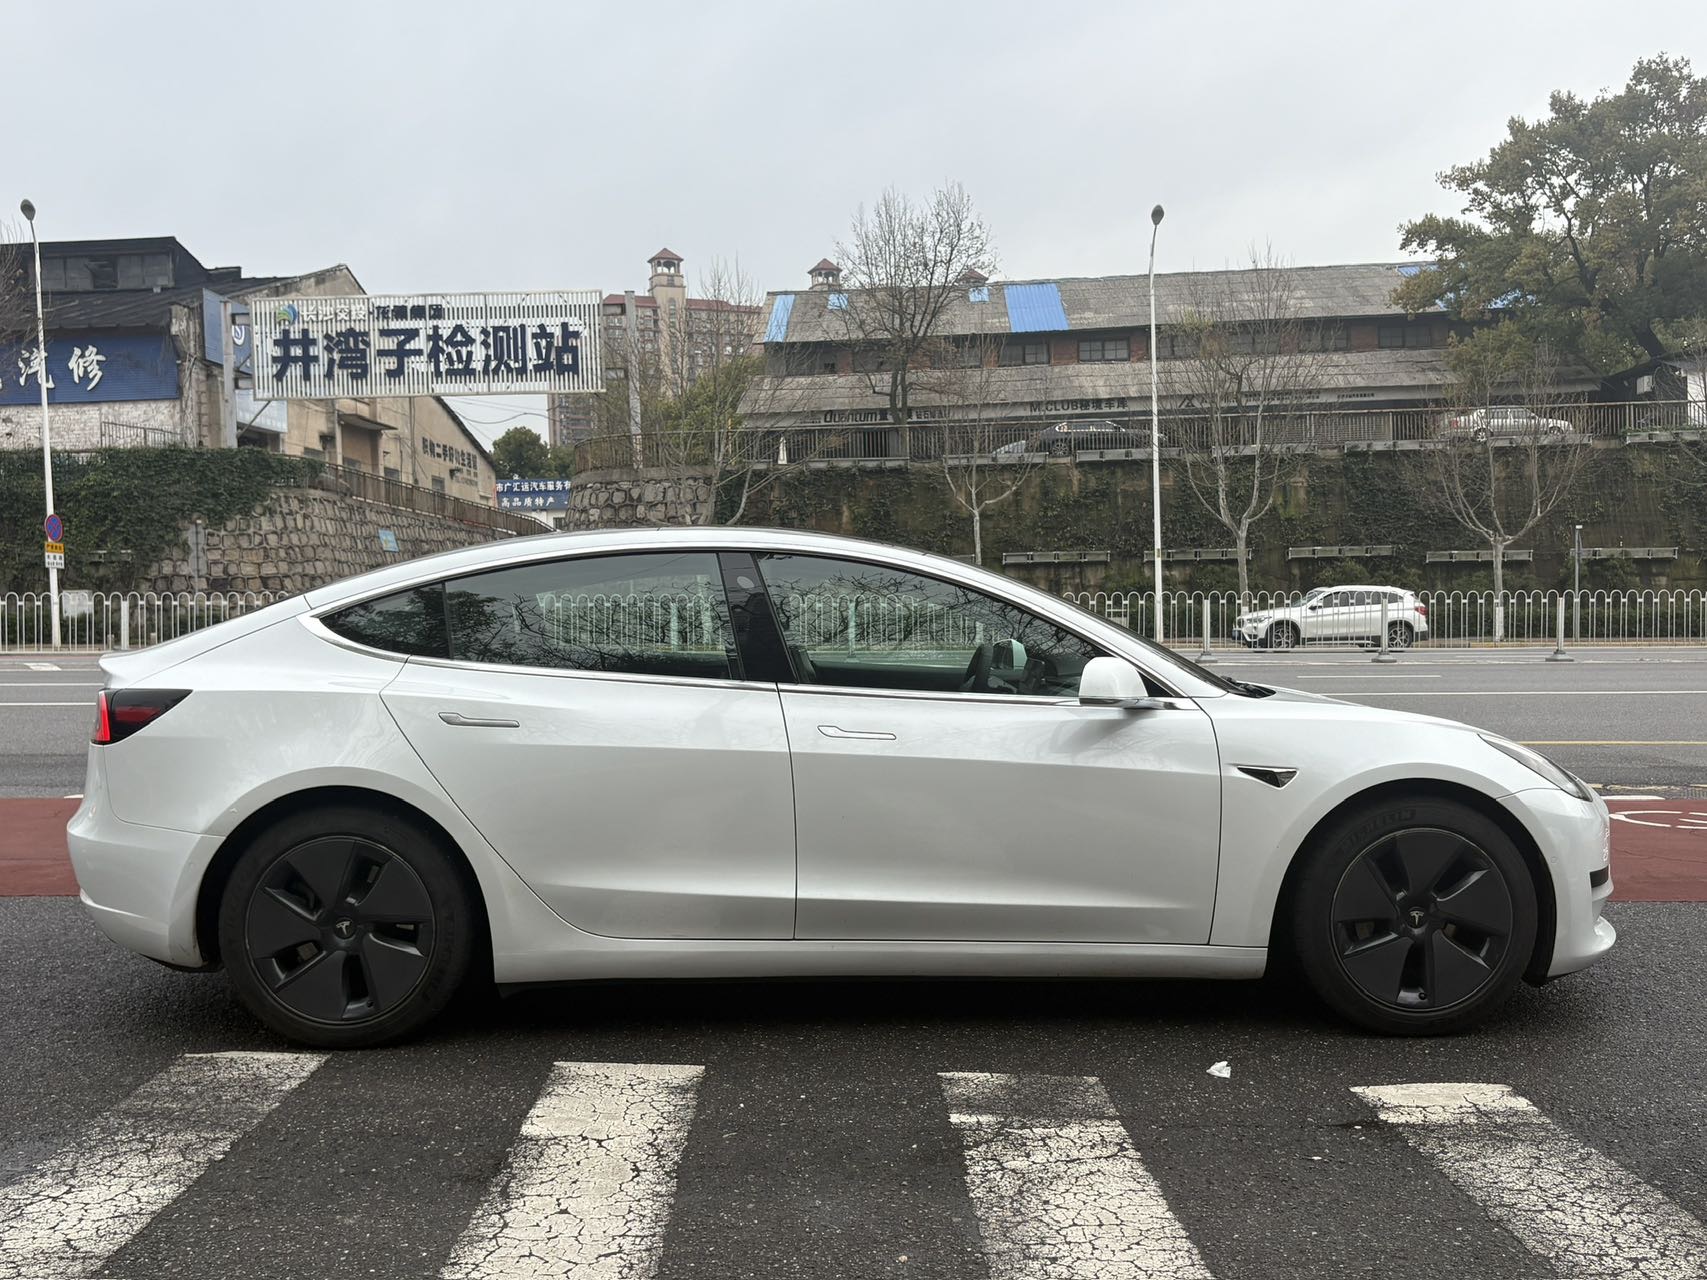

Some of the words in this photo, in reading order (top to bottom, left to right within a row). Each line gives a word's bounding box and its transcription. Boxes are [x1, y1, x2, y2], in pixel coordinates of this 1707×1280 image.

[0, 345, 107, 391] 汽修
[272, 322, 583, 382] 井湾子检测站
